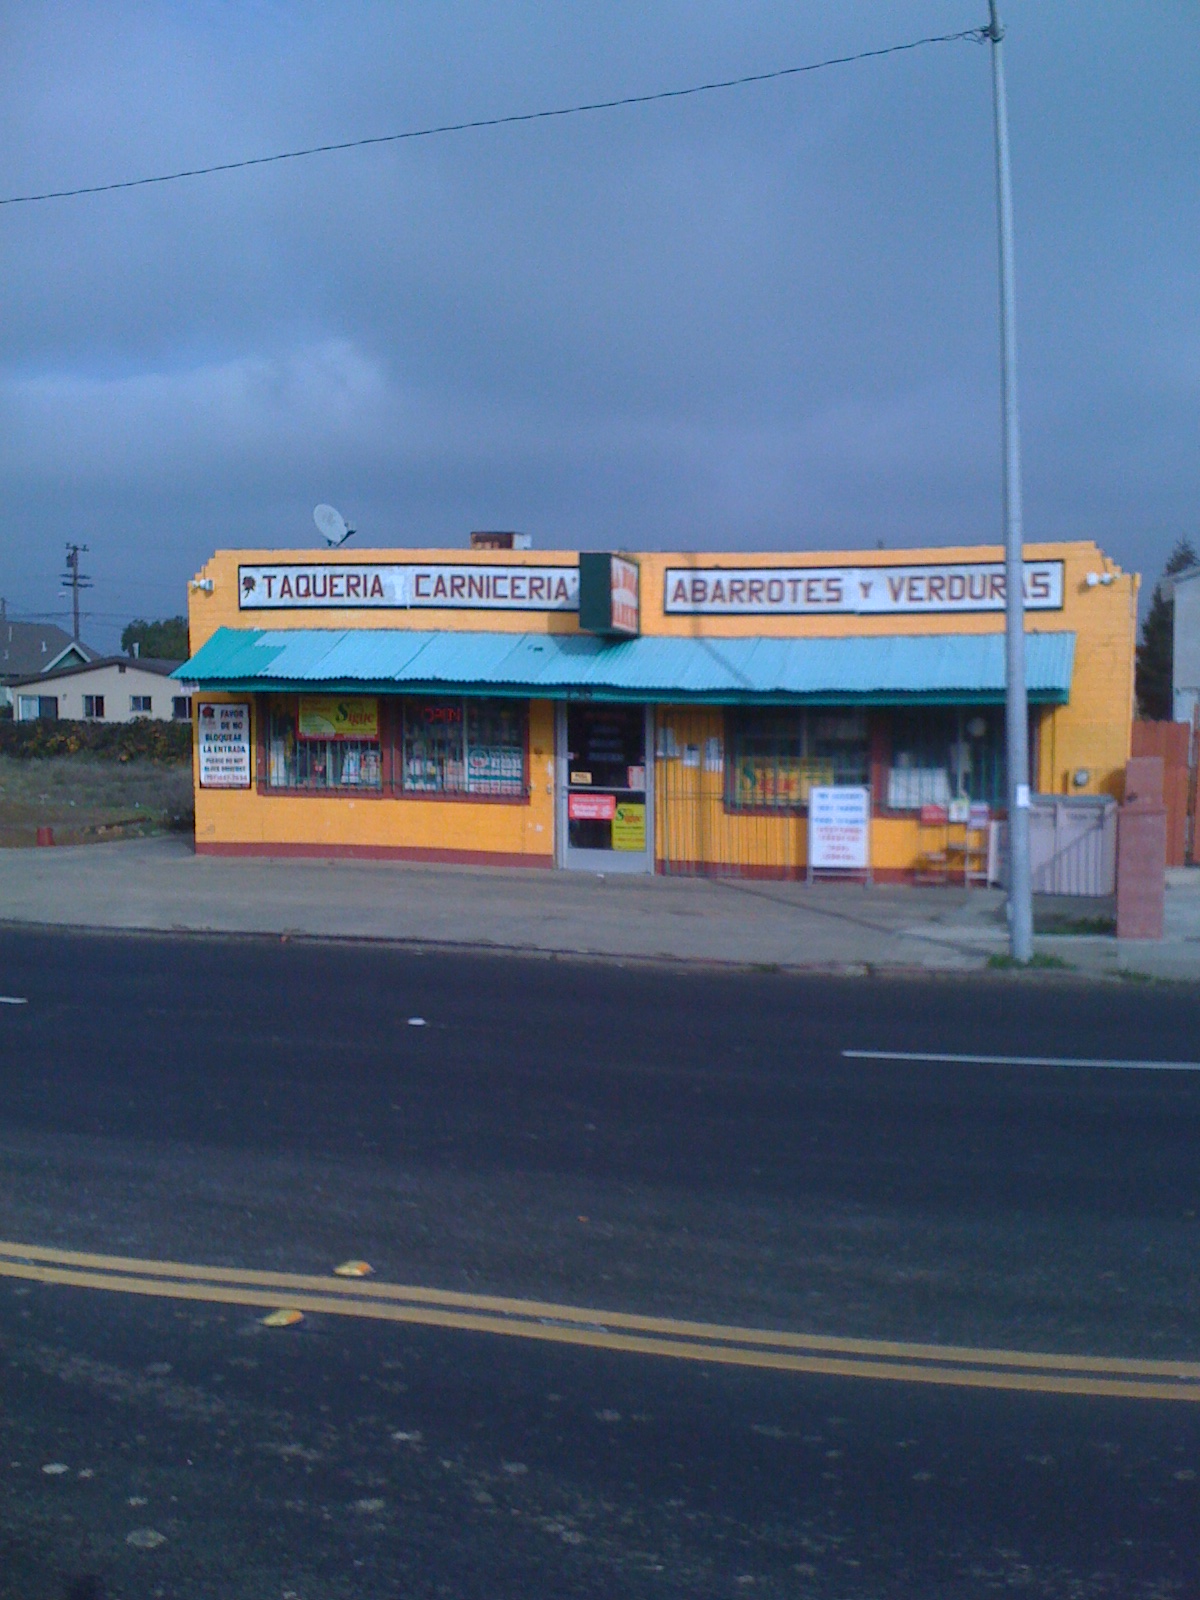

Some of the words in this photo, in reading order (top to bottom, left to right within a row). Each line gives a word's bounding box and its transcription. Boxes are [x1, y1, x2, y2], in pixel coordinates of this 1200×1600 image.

[262, 574, 385, 599] TAQUERIA
[414, 573, 570, 601] CARNICERIA
[672, 577, 843, 604] ABARROTES
[858, 580, 873, 599] Y
[887, 571, 1050, 602] VERDURS
[220, 709, 243, 718] FAVOR
[220, 721, 230, 730] DE
[232, 721, 243, 729] NO
[205, 733, 242, 743] BLOQUEAR
[203, 745, 212, 753] LA
[213, 745, 246, 753] ENTRADA
